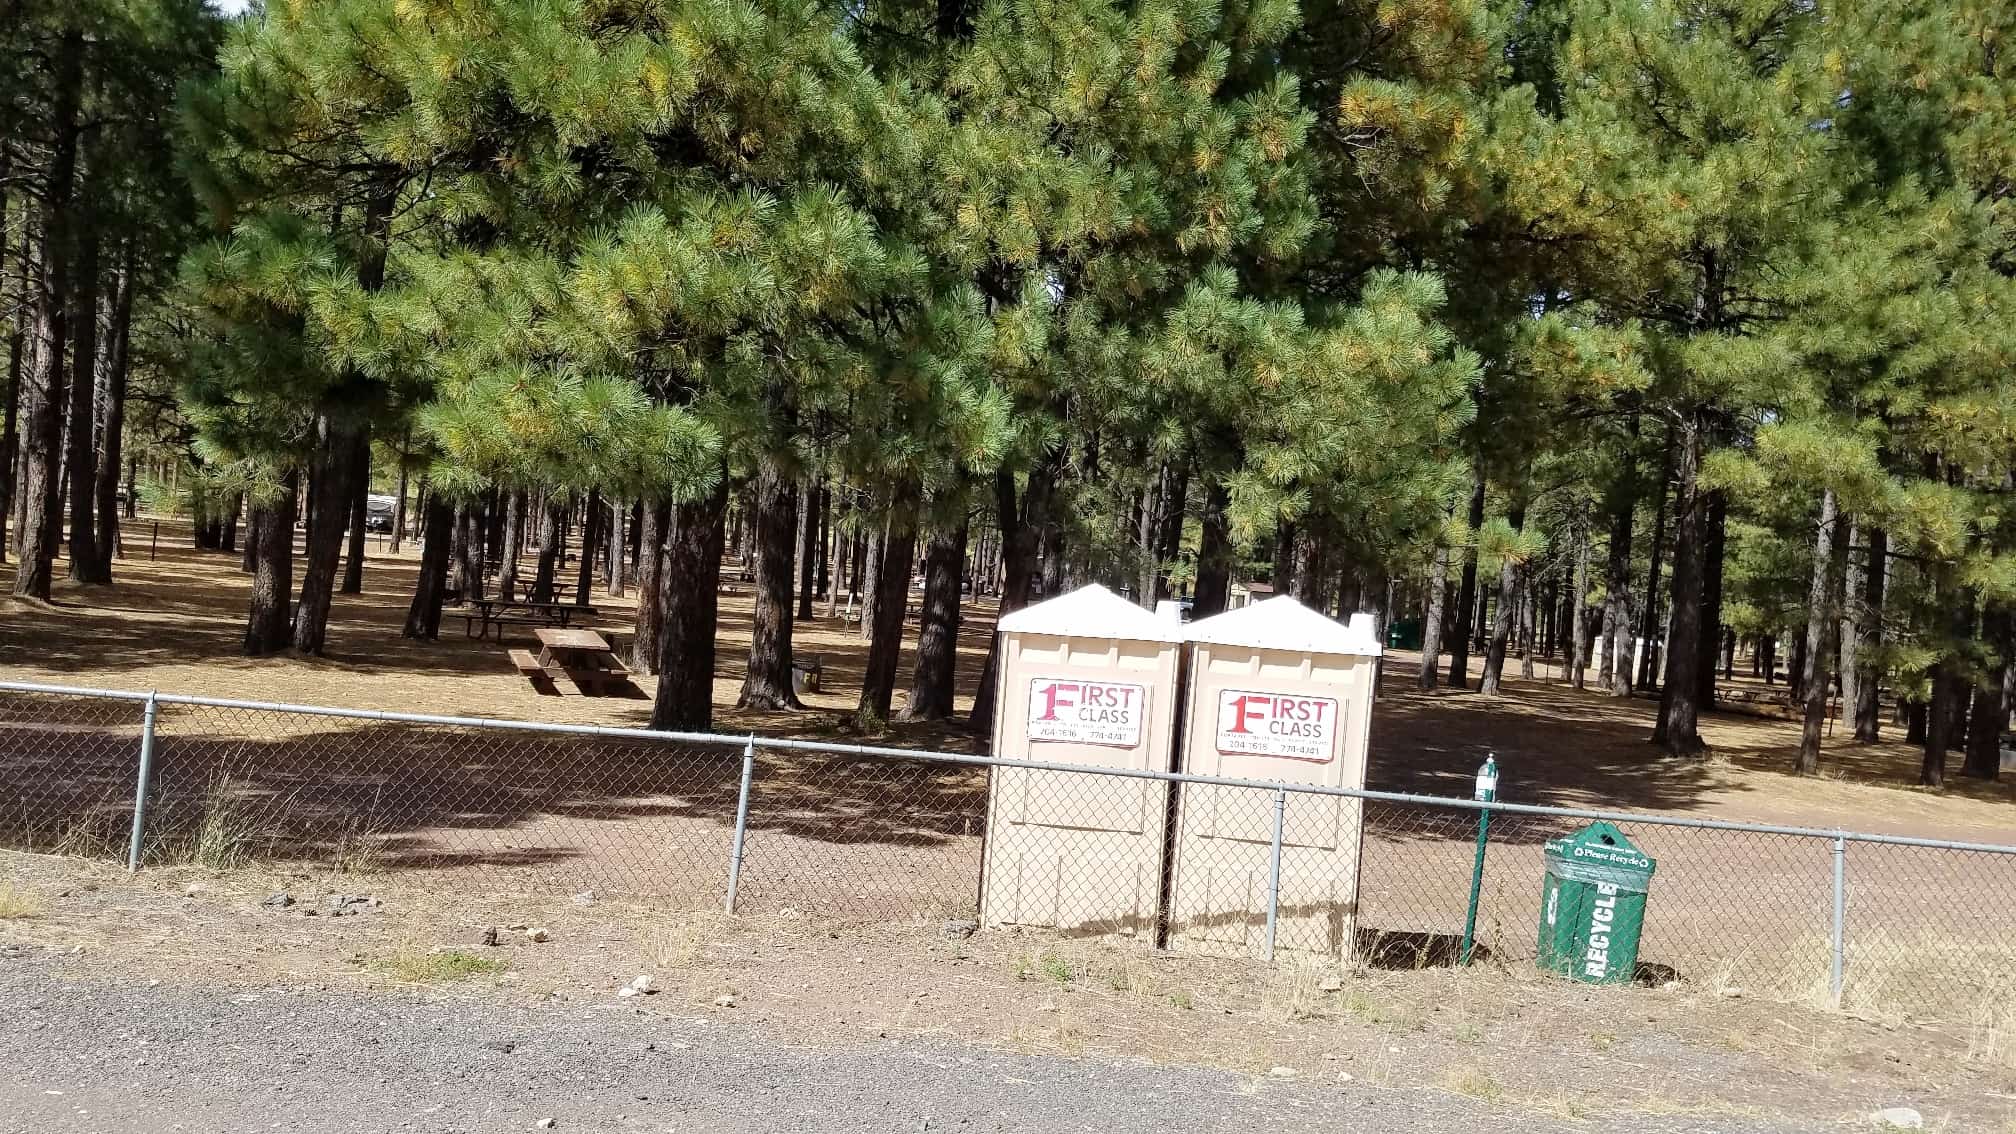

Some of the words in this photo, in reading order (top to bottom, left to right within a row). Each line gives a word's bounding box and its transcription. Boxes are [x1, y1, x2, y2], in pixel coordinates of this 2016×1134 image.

[1078, 707, 1129, 724] CLASS
[1269, 720, 1322, 738] CLASS
[1584, 848, 1609, 860] Please
[1609, 853, 1639, 866] Recycle
[1585, 881, 1620, 978] RECYCLE
